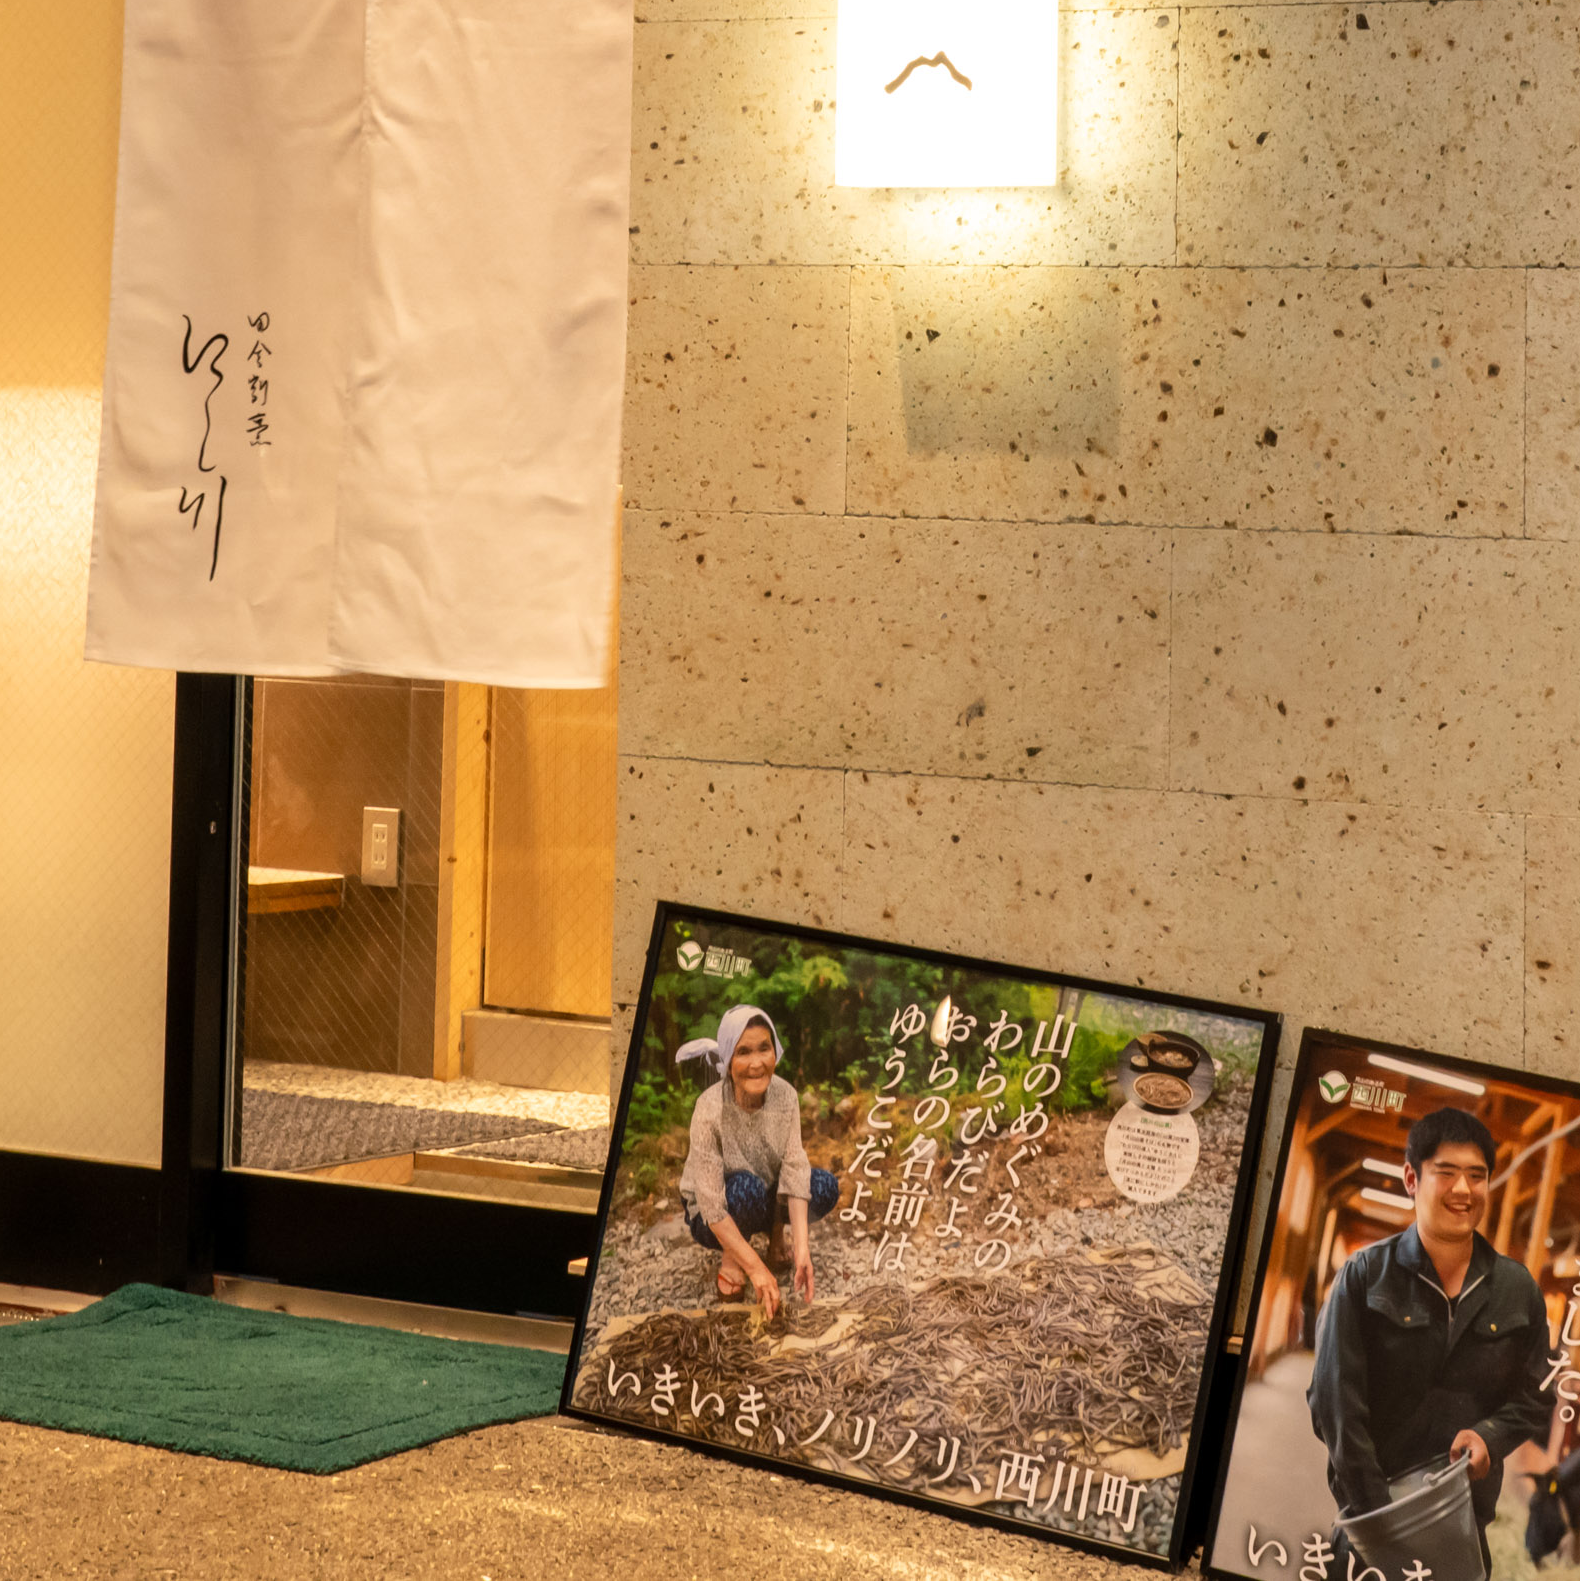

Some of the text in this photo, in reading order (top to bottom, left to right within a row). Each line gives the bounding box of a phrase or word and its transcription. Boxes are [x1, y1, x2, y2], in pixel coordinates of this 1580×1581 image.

[839, 1003, 927, 1223] ゆうこだよ
[873, 1005, 978, 1272] おらの名前は
[934, 1009, 1024, 1238] わらびだよ
[974, 1013, 1078, 1273] 山のめぐみの
[1350, 1082, 1407, 1113] 西川町
[606, 1357, 1148, 1533] いきいき、ノリノリ、西川町
